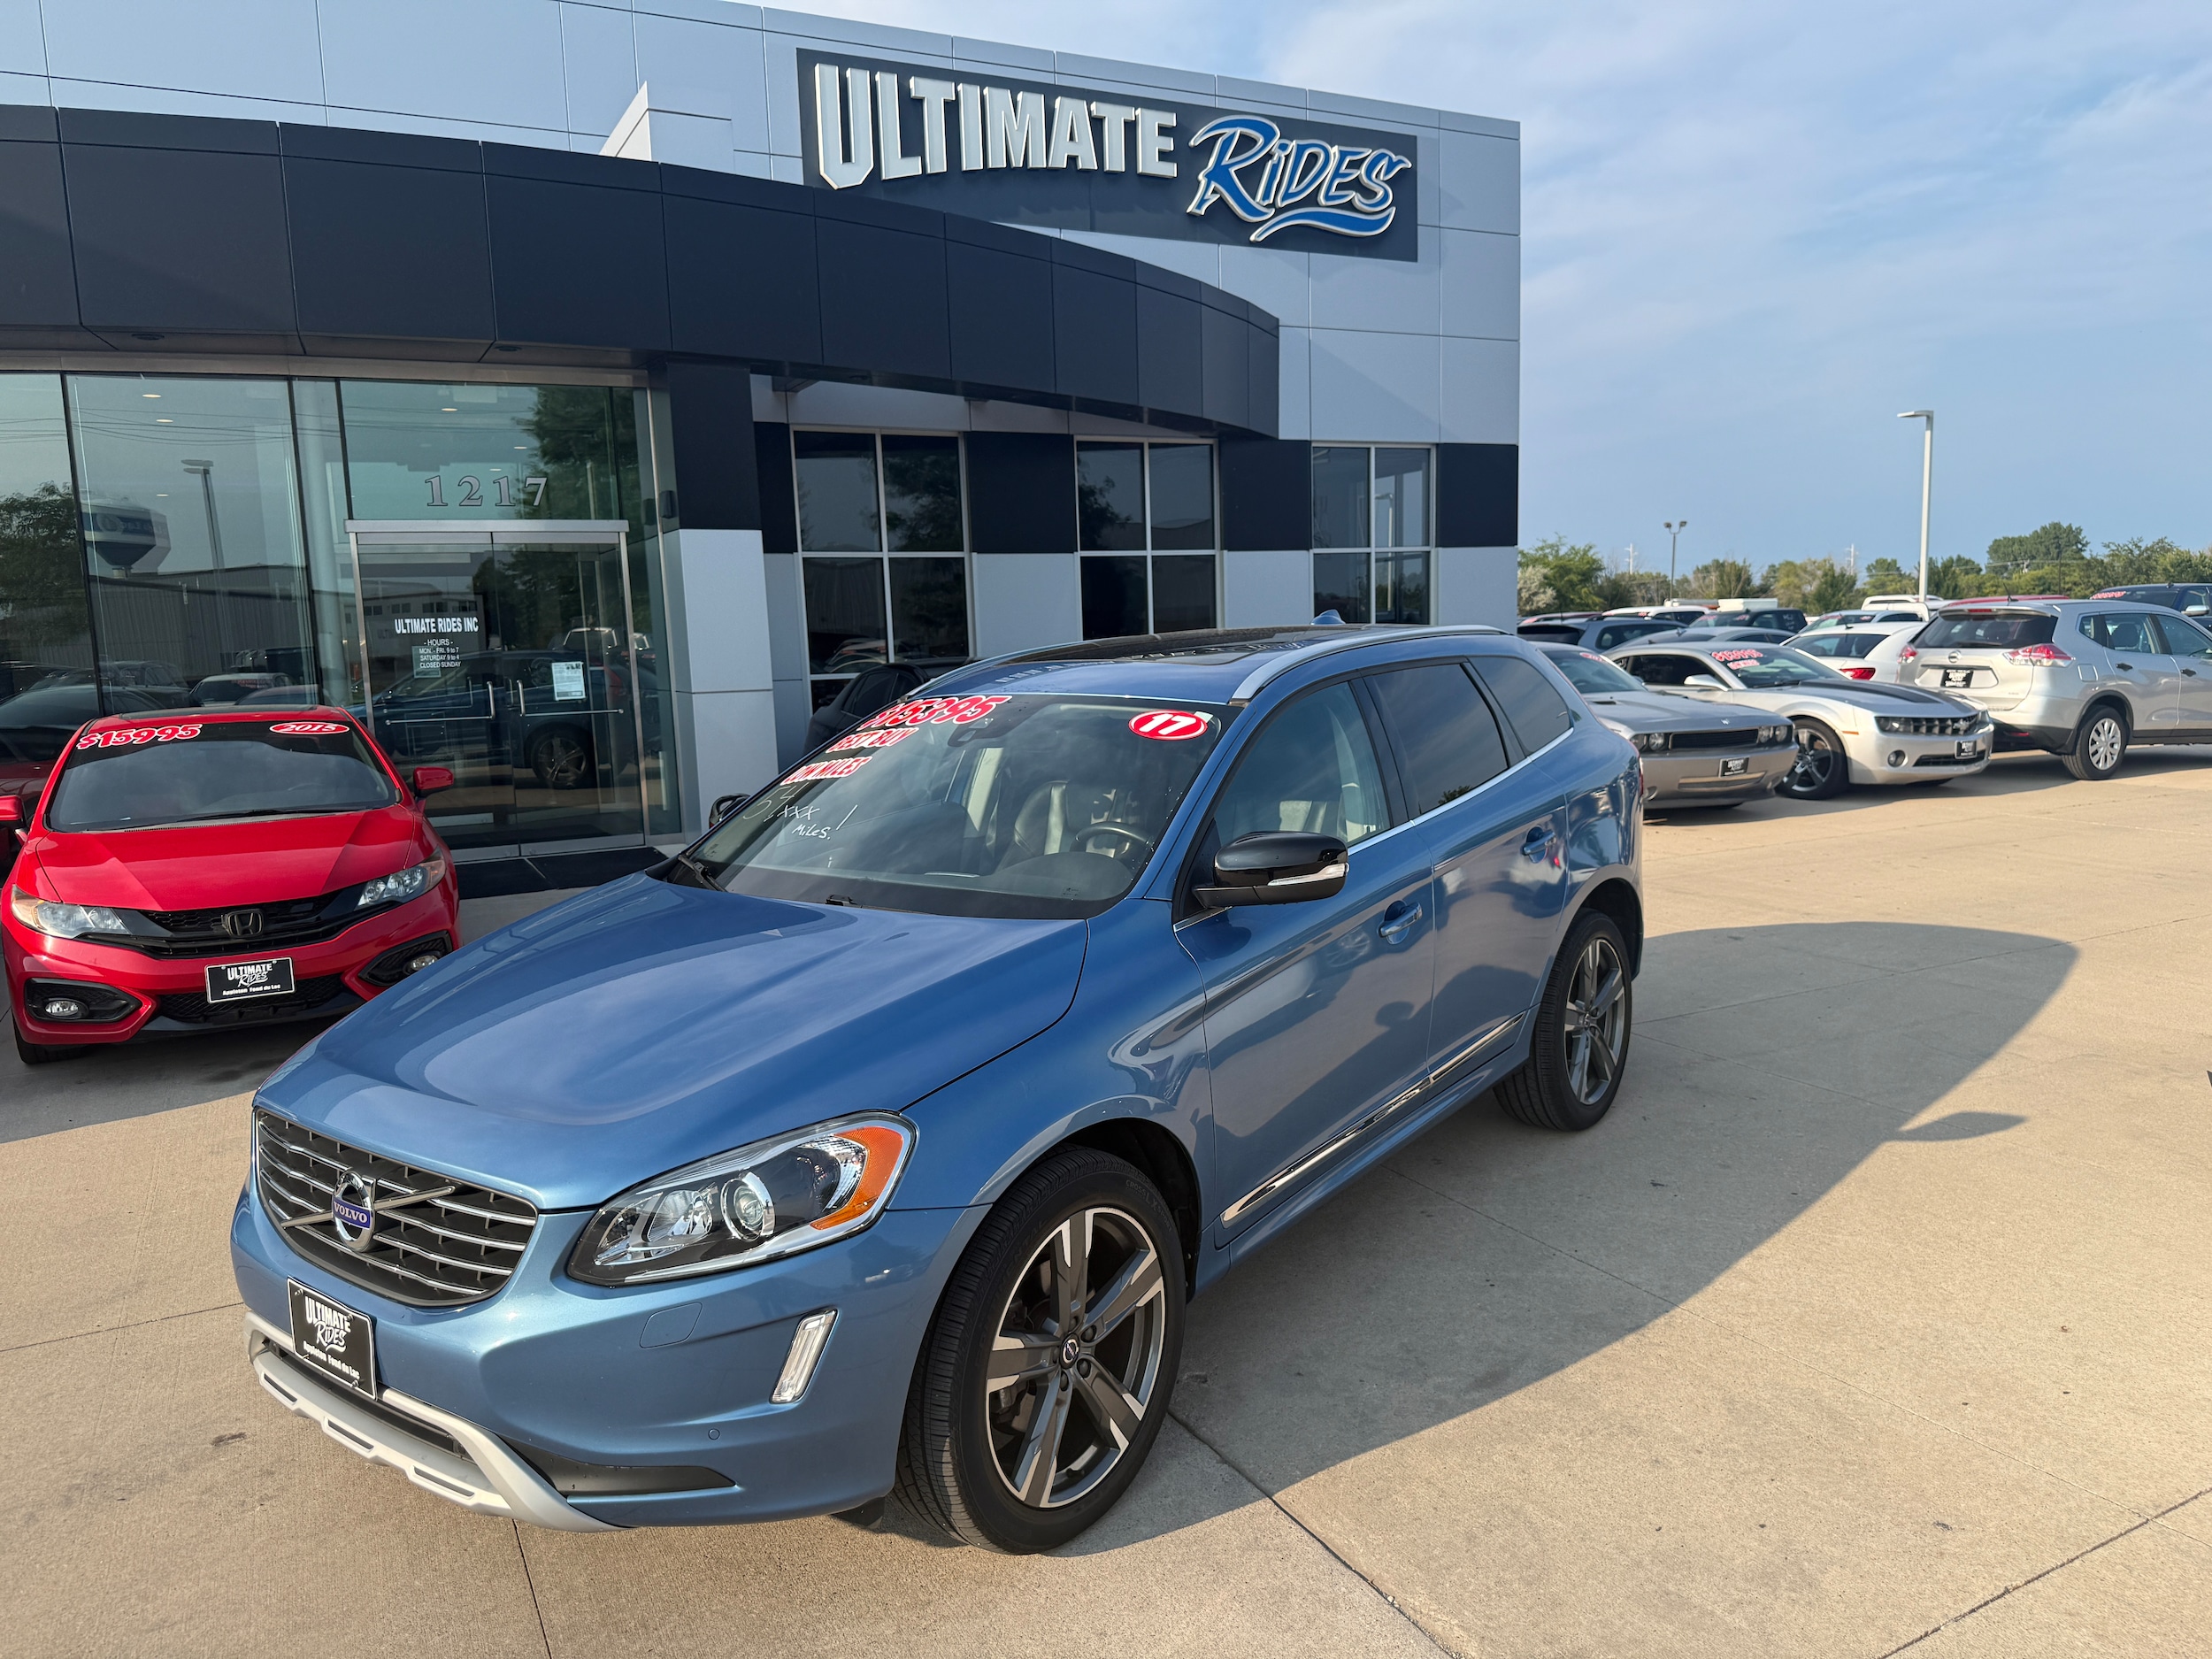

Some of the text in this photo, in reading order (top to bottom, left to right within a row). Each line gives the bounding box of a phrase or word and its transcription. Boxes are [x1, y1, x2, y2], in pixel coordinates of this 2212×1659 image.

[814, 63, 1412, 242] ULTIMATE RIDES
[425, 474, 548, 507] 1217
[395, 617, 479, 634] ULTIMATE RIDES INC
[280, 723, 337, 733] 2015
[1139, 713, 1196, 735] 17
[76, 724, 204, 750] $15995
[227, 963, 273, 980] ULTIMATE
[236, 972, 269, 987] RIDES
[334, 1202, 368, 1225] VOLVO
[305, 1295, 351, 1333] ULTIMATE
[314, 1320, 347, 1352] RIDES
[303, 1340, 327, 1362] Appleton
[327, 1354, 342, 1370] Fond
[342, 1363, 349, 1375] du
